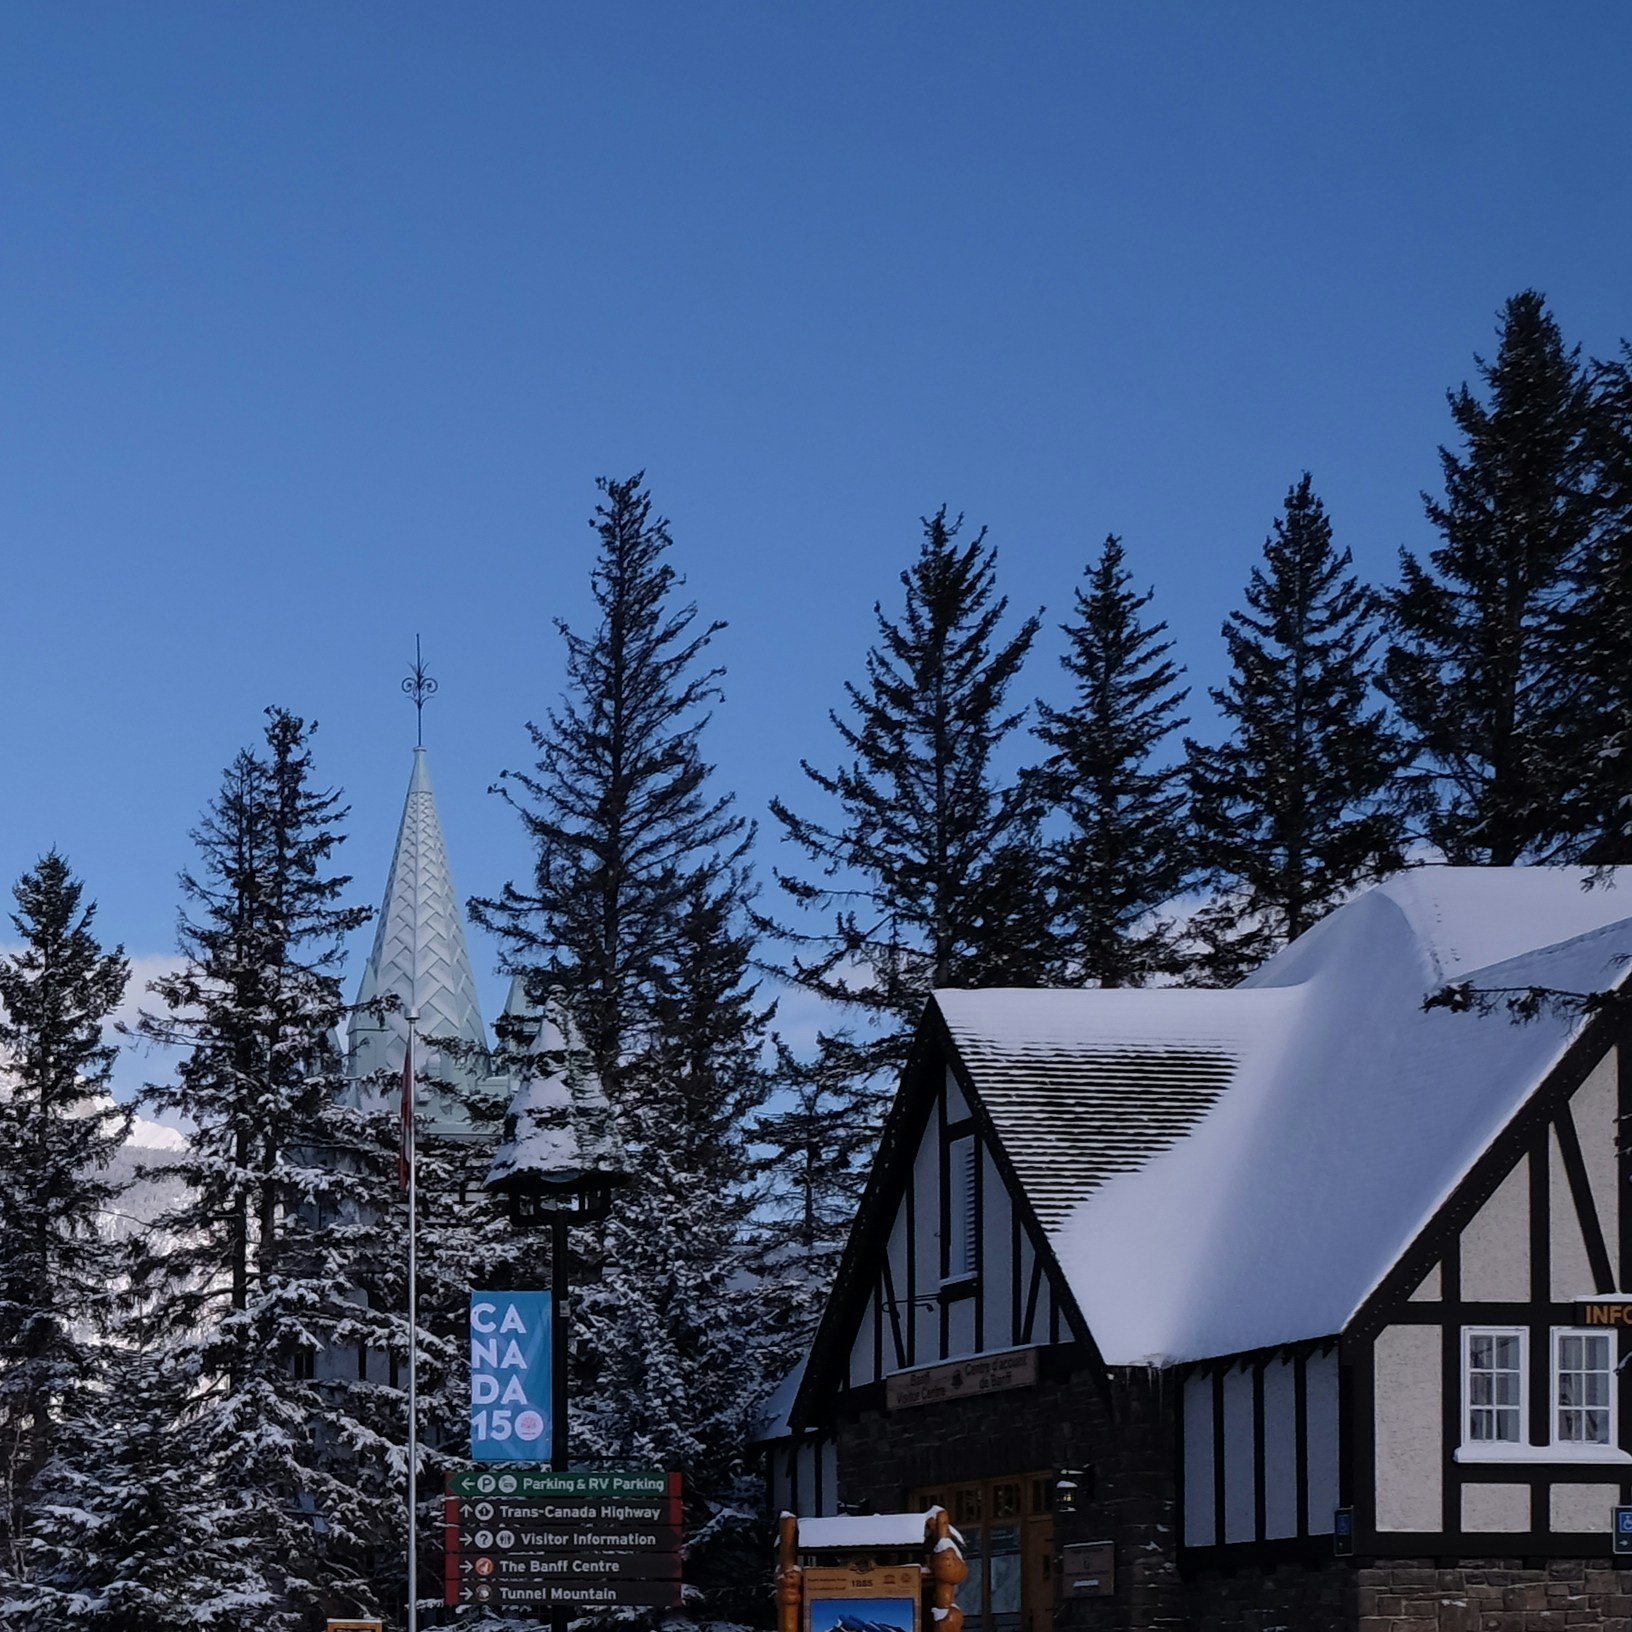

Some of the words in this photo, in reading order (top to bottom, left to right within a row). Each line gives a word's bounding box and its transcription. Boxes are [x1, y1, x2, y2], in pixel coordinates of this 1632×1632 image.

[470, 1303, 527, 1334] CA
[471, 1338, 528, 1369] NA
[471, 1374, 528, 1404] DA
[471, 1410, 544, 1441] 150
[523, 1478, 574, 1493] Parking
[577, 1479, 586, 1490] &
[588, 1478, 609, 1490] RV
[613, 1478, 665, 1493] Parking
[499, 1505, 596, 1518] Trans-Canada
[601, 1505, 661, 1521] Highway
[520, 1532, 569, 1546] Visitor
[573, 1532, 656, 1546] Information
[499, 1560, 526, 1572] The
[530, 1560, 568, 1572] Banff
[572, 1559, 620, 1573] Centre
[499, 1587, 546, 1600] Tunnel
[550, 1587, 617, 1600] Mountain
